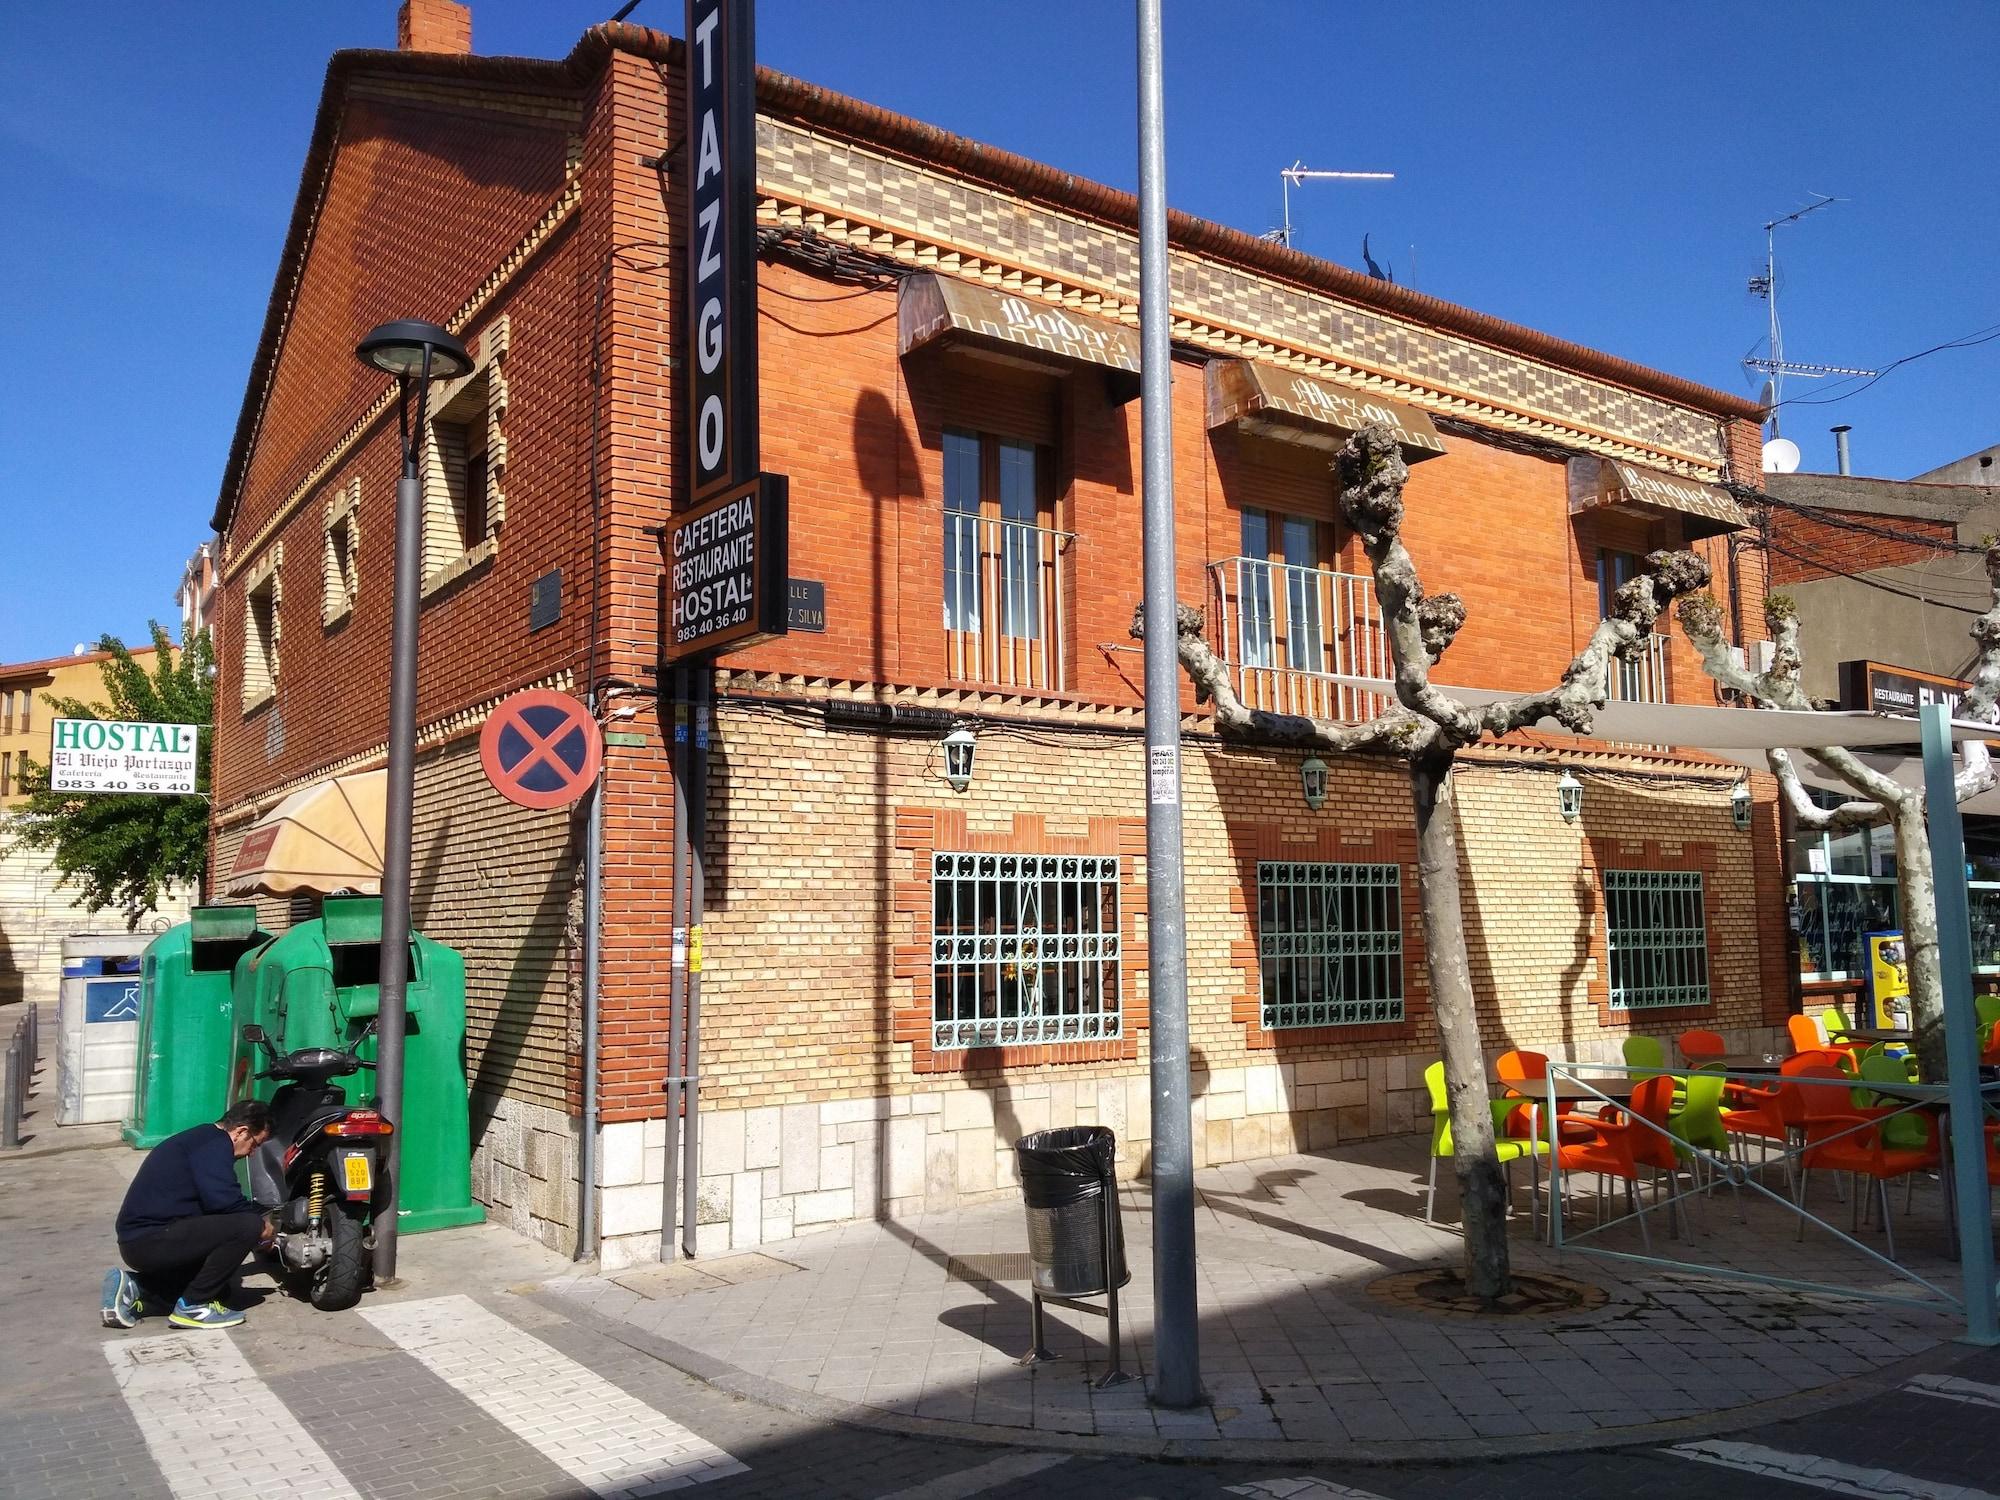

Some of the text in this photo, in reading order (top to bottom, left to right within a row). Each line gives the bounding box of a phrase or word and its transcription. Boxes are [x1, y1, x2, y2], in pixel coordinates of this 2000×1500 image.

[696, 0, 724, 471] TAZGO
[1622, 465, 1742, 514] Banquetes
[673, 496, 753, 557] CAFETERIA
[672, 533, 754, 593] RESTAURANTE
[672, 572, 753, 627] HOSTAL
[790, 586, 808, 600] LLE
[677, 607, 747, 643] 983 40 36 40
[799, 608, 823, 625] SILVA
[1874, 688, 1914, 705] RESTAURANTE
[56, 721, 190, 753] HOSTAL
[55, 752, 192, 773] El Viejo Portazgo
[132, 771, 188, 780] Restaurante
[57, 780, 191, 791] 983 40 36 40
